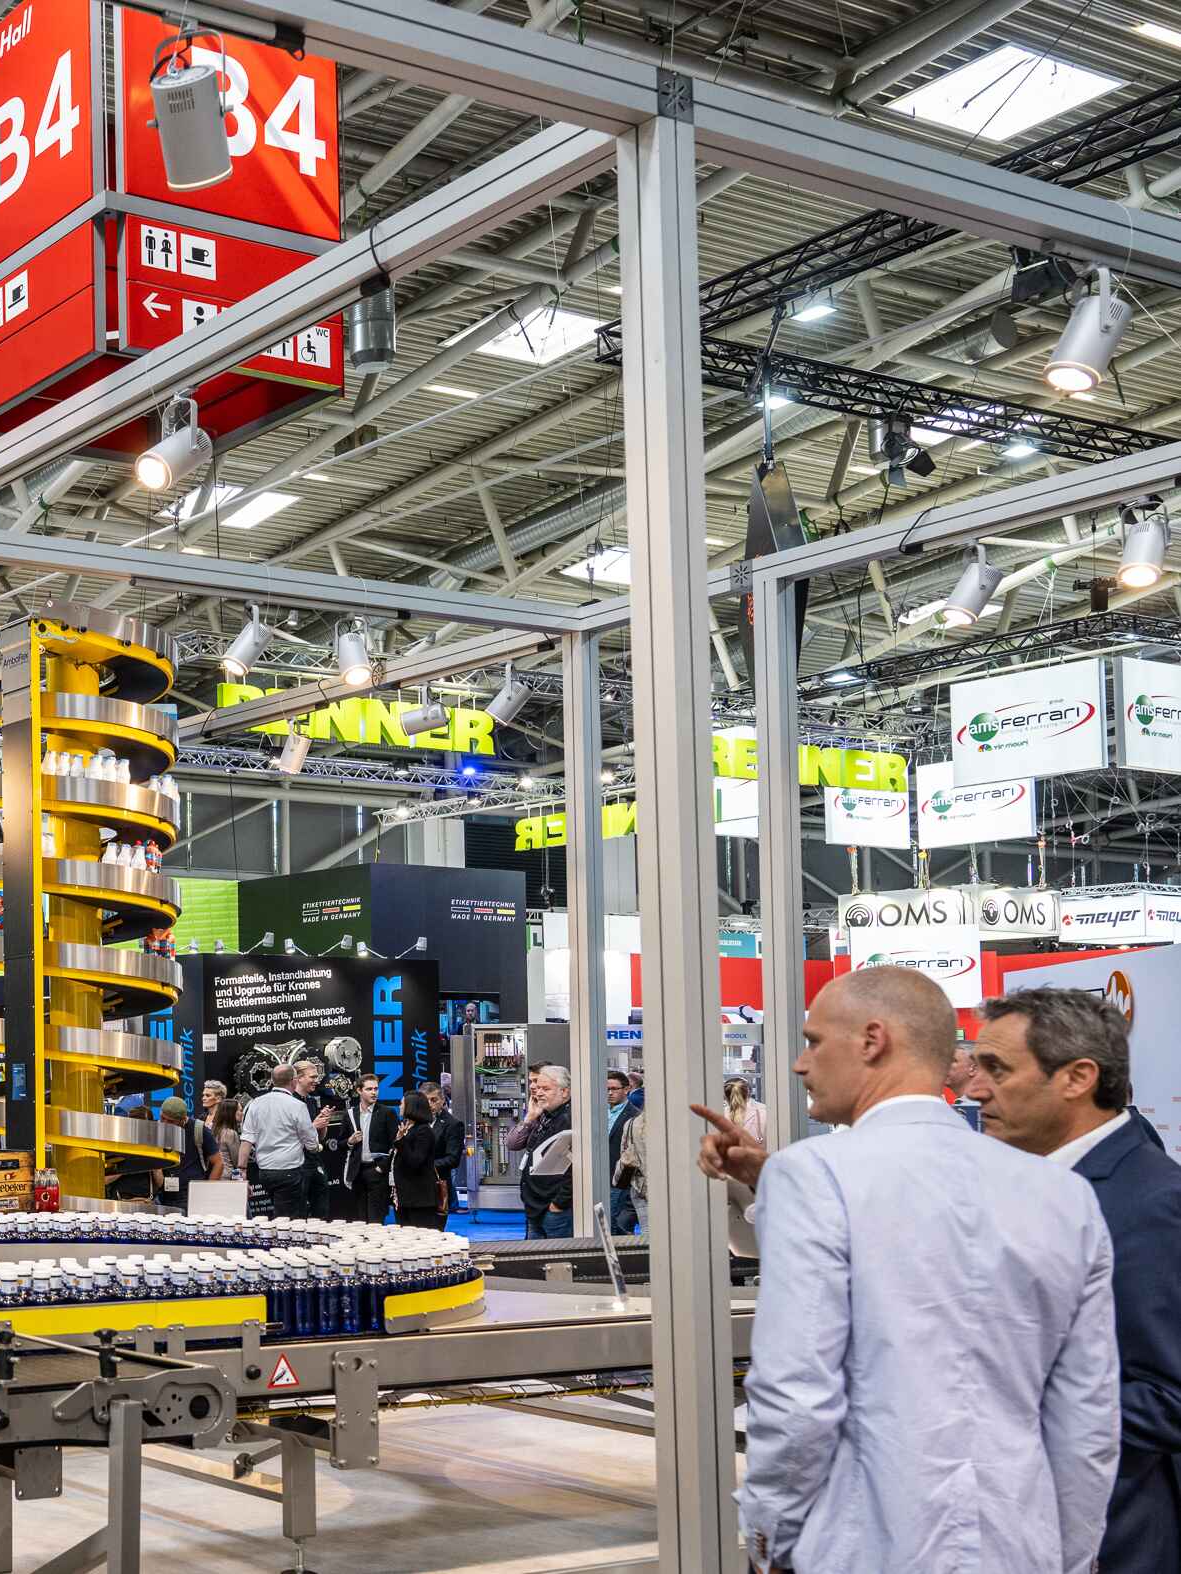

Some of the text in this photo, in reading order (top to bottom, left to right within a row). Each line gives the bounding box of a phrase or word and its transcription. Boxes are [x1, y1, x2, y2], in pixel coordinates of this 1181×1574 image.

[0, 5, 32, 57] Hall
[315, 327, 329, 338] WC
[969, 720, 999, 735] ams
[1001, 706, 1080, 729] Ferrari
[712, 735, 908, 792] RENER
[954, 786, 1015, 804] Ferrari
[302, 897, 361, 910] ETIKETTIERTECHNIK
[450, 899, 516, 908] ETIKETTIERTECHNIK
[878, 899, 948, 925] OMS
[1004, 900, 1046, 926] OMS
[302, 915, 320, 923] MADE
[330, 911, 361, 920] GERMANY
[214, 969, 332, 987] Formatteile, Instandhaltung
[215, 979, 322, 998] und Upgrade für Krones
[216, 992, 307, 1009] Etikettiermaschinen
[218, 1006, 346, 1026] Retrofitting parts, maintenance
[219, 1016, 353, 1037] and upgrade for Krones labeller
[607, 1030, 643, 1042] REN
[180, 1028, 195, 1114] echnik
